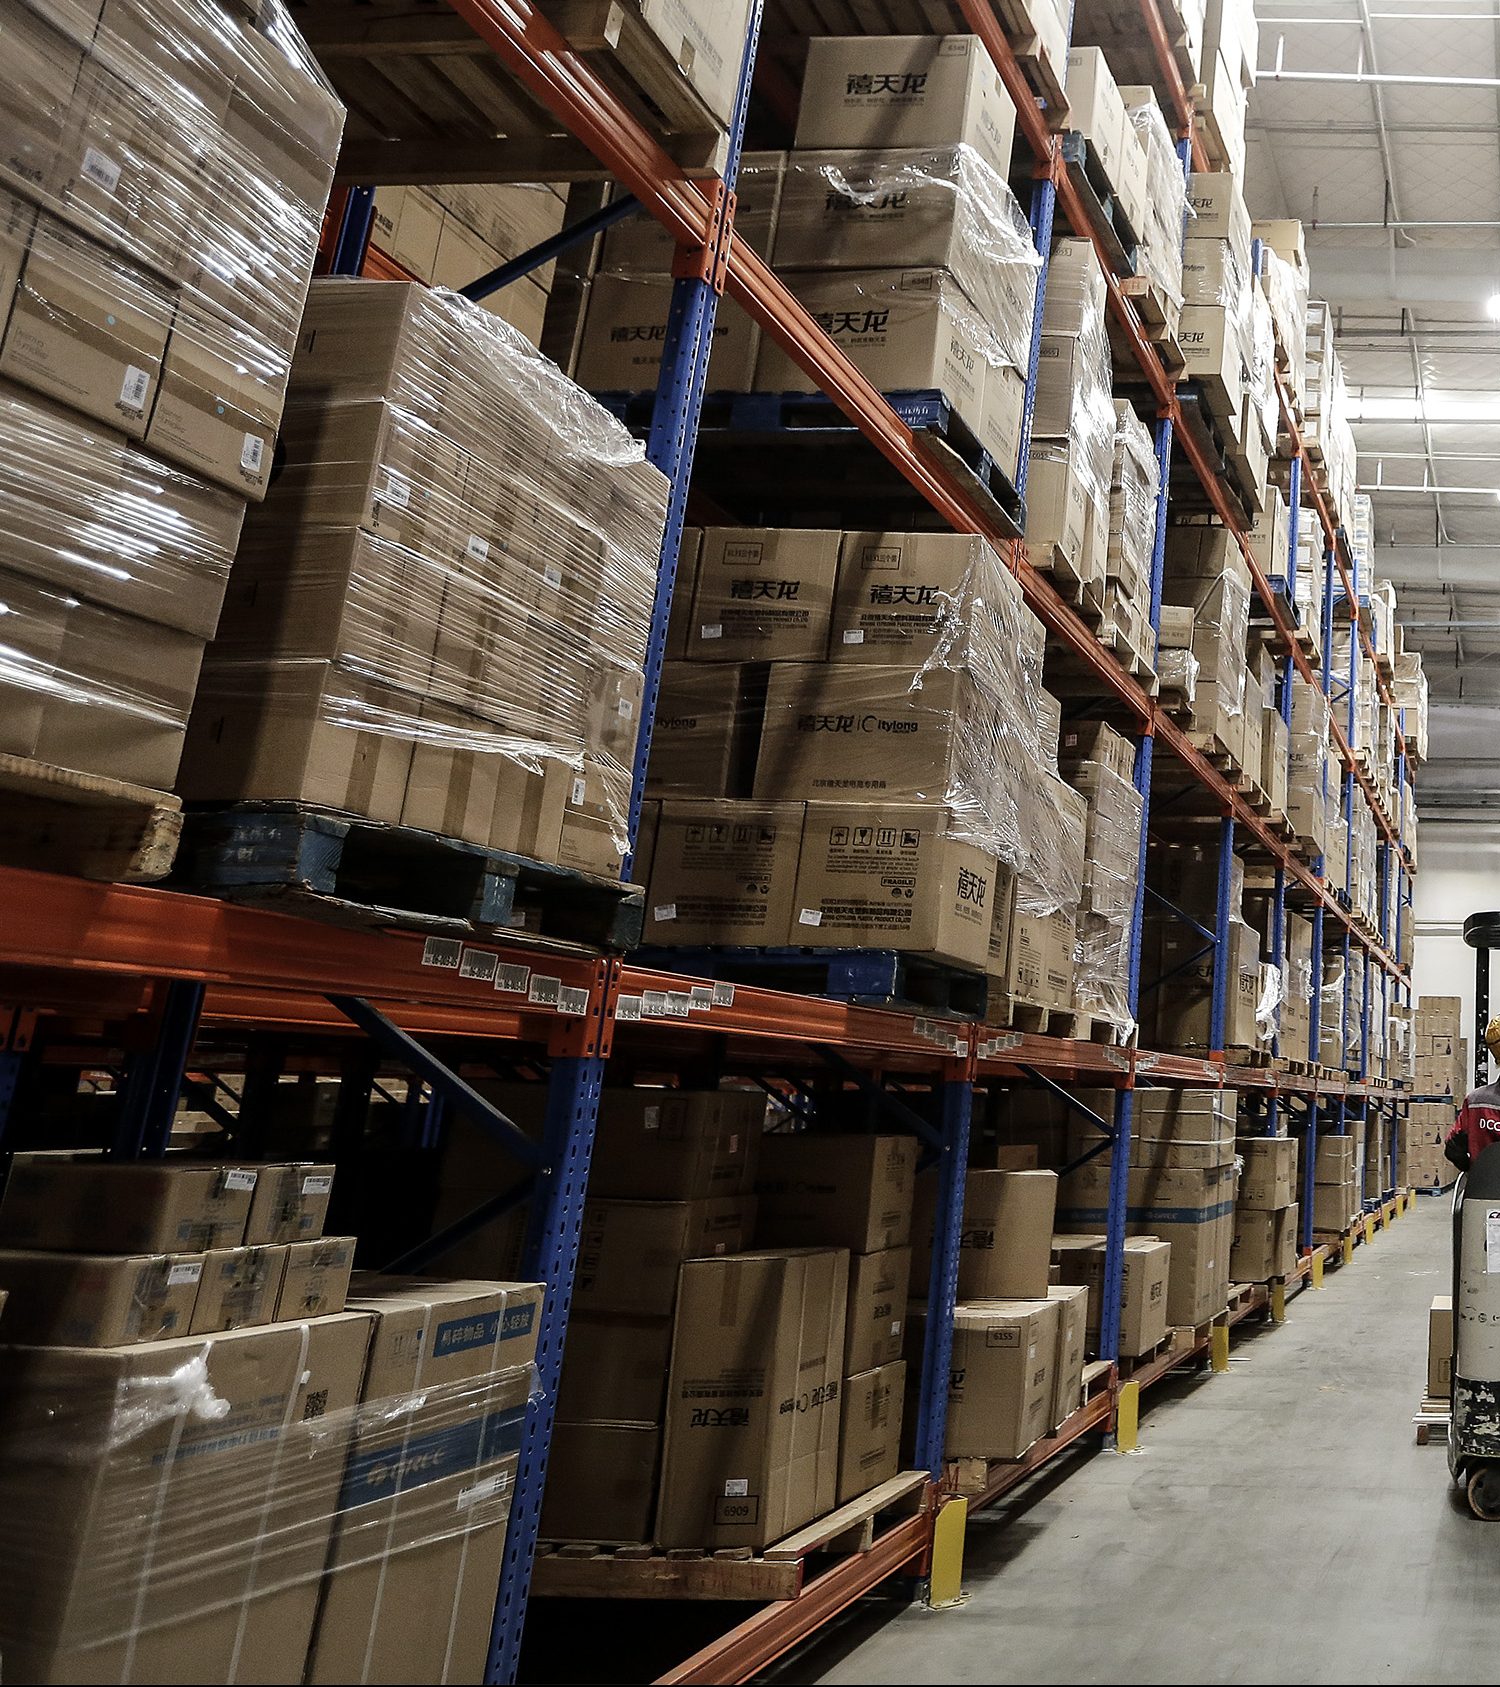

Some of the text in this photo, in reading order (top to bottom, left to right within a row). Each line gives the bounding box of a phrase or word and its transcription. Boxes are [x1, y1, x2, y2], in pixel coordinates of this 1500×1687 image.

[847, 72, 927, 95] 禧天龙
[731, 580, 800, 600] 禧天龙
[870, 584, 940, 606] 禧天龙
[957, 866, 987, 908] 禧天龙
[690, 1407, 750, 1428] 禧天龙
[724, 1505, 749, 1517] 6909
